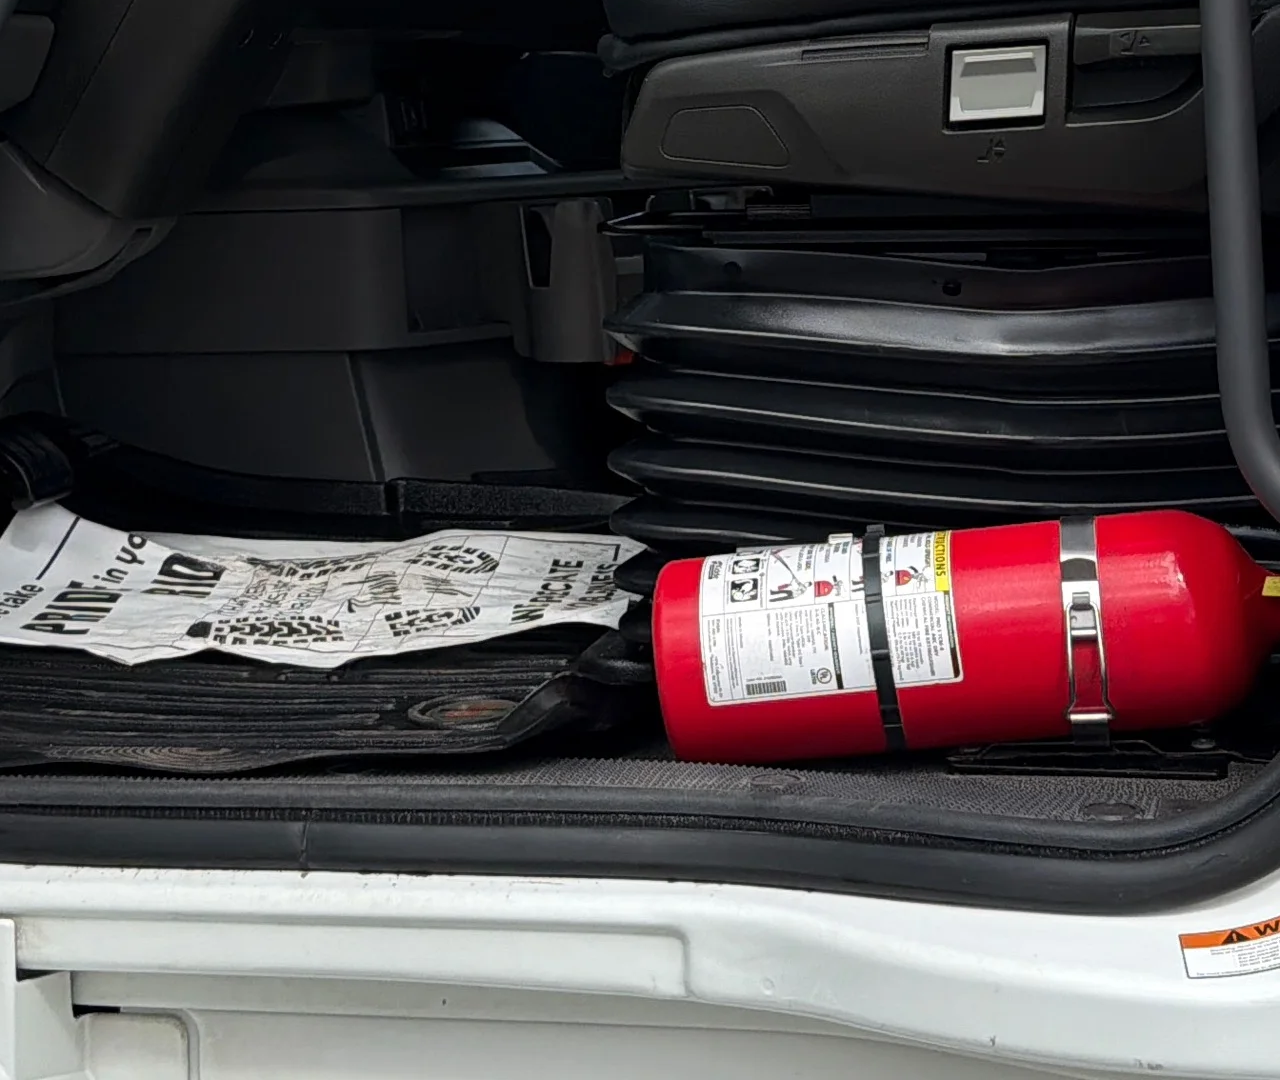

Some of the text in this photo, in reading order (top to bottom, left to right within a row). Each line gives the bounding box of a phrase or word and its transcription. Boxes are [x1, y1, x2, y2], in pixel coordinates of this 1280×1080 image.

[20, 580, 132, 635] PRIDE
[92, 568, 129, 584] in
[140, 553, 228, 598] RID
